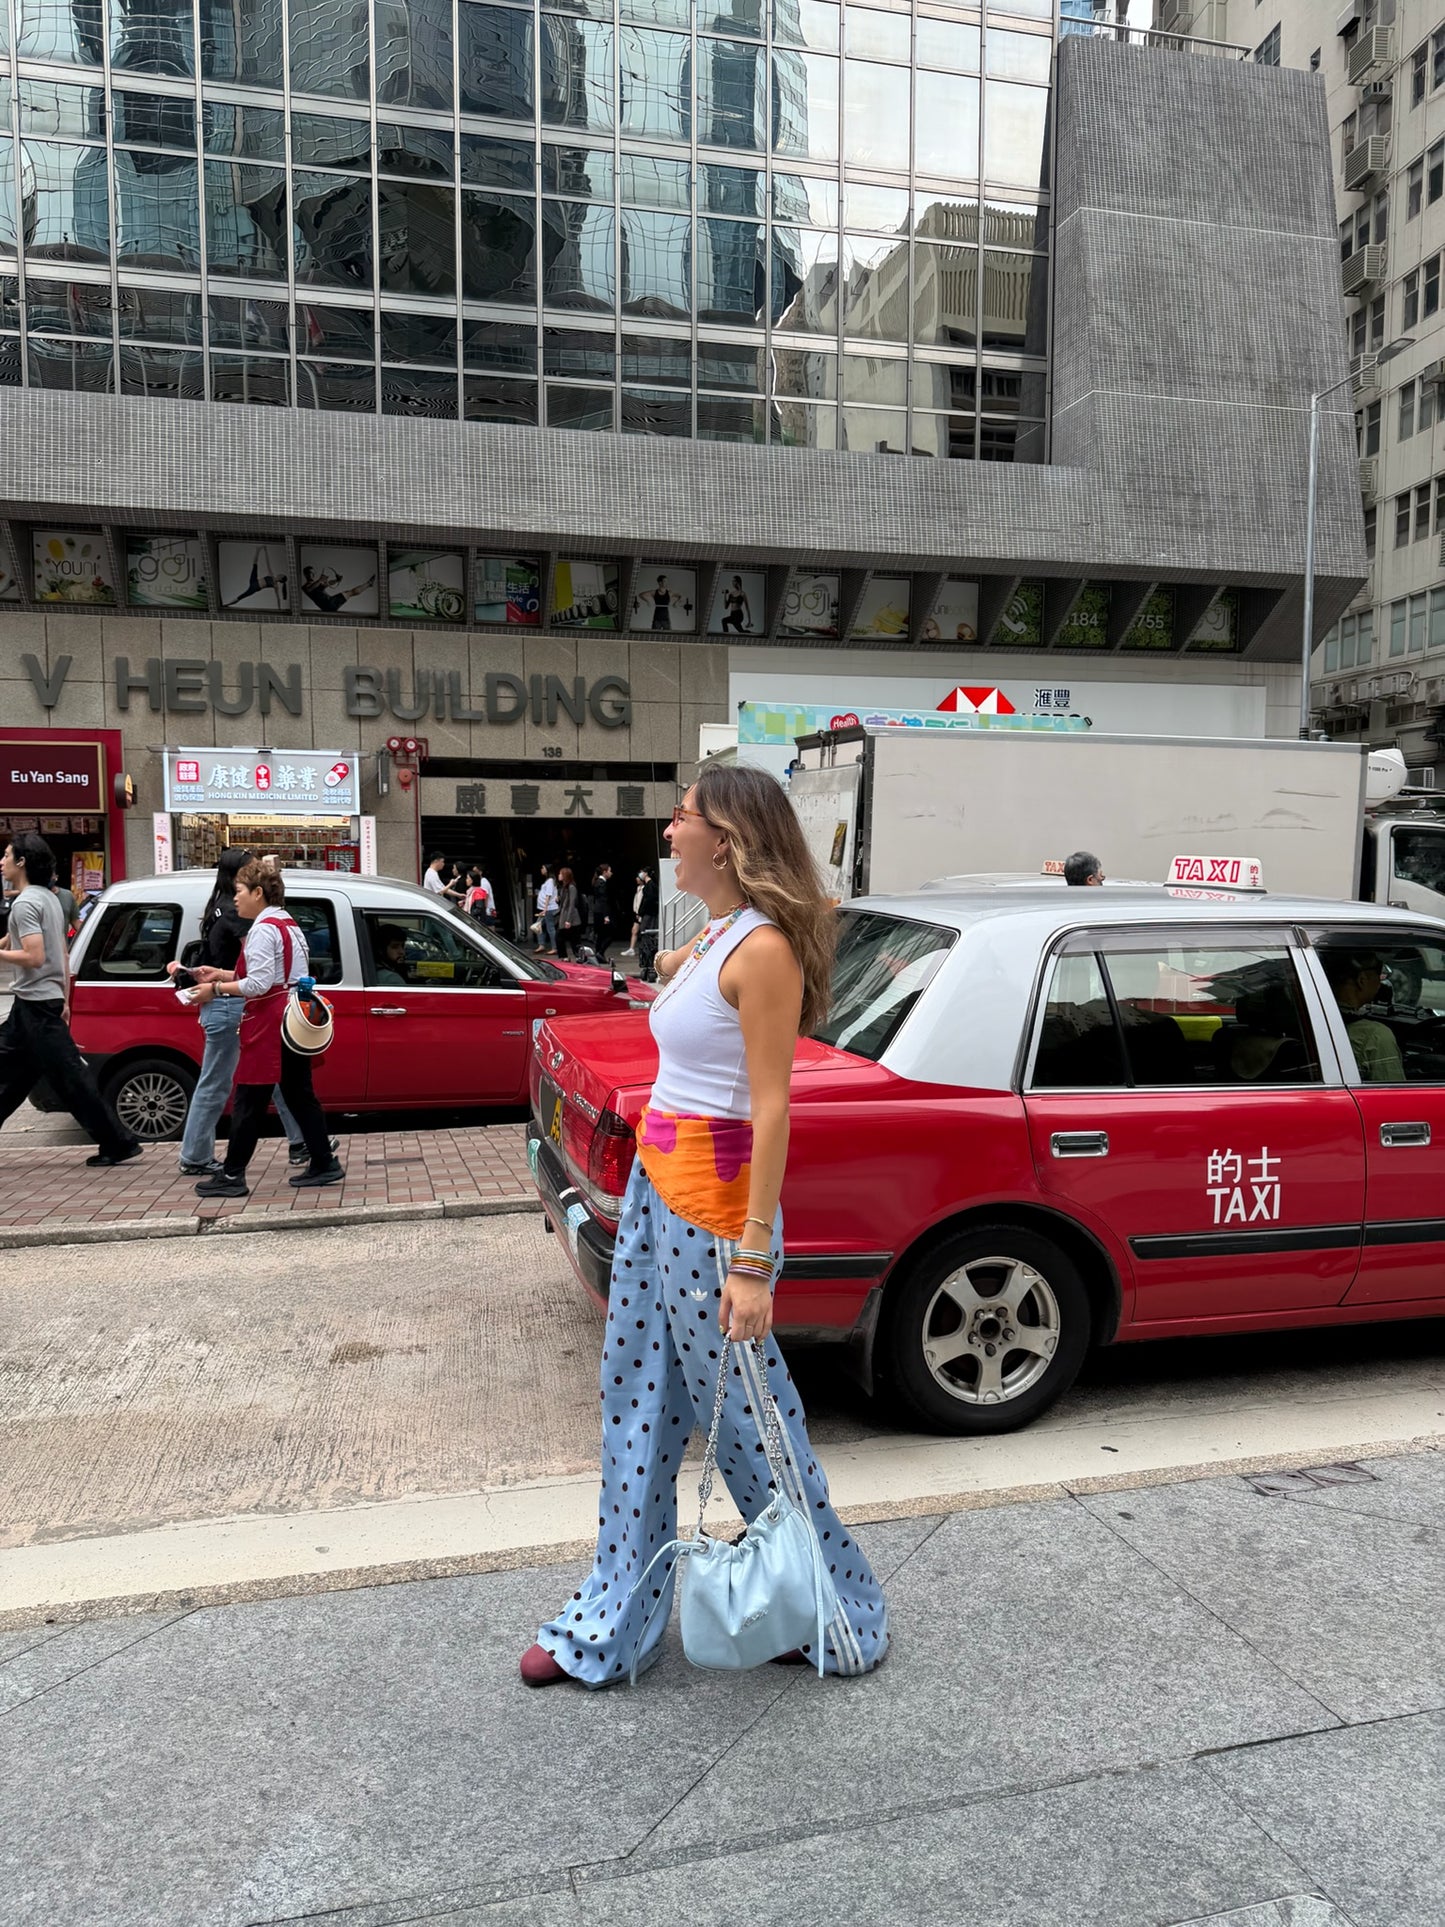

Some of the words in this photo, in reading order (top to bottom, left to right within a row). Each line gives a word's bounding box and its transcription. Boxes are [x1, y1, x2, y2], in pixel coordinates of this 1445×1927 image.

[1065, 612, 1099, 626] 184
[22, 653, 73, 707] V
[115, 656, 302, 716] HEUN
[344, 665, 633, 728] BUILDING
[833, 714, 857, 729] Health
[541, 746, 563, 758] 138
[11, 770, 28, 783] Eu
[29, 770, 54, 783] Yan
[55, 770, 90, 787] Sang
[207, 764, 254, 790] 康健
[257, 767, 268, 788] 中西
[274, 764, 319, 791] 藥業
[249, 792, 287, 800] MEDICINE
[288, 793, 319, 801] LIMITED
[1045, 861, 1065, 873] TAX
[1174, 858, 1242, 883] TAXI
[1250, 865, 1259, 885] 的士
[1207, 1146, 1282, 1185] 的士
[1206, 1183, 1281, 1225] TAXI
